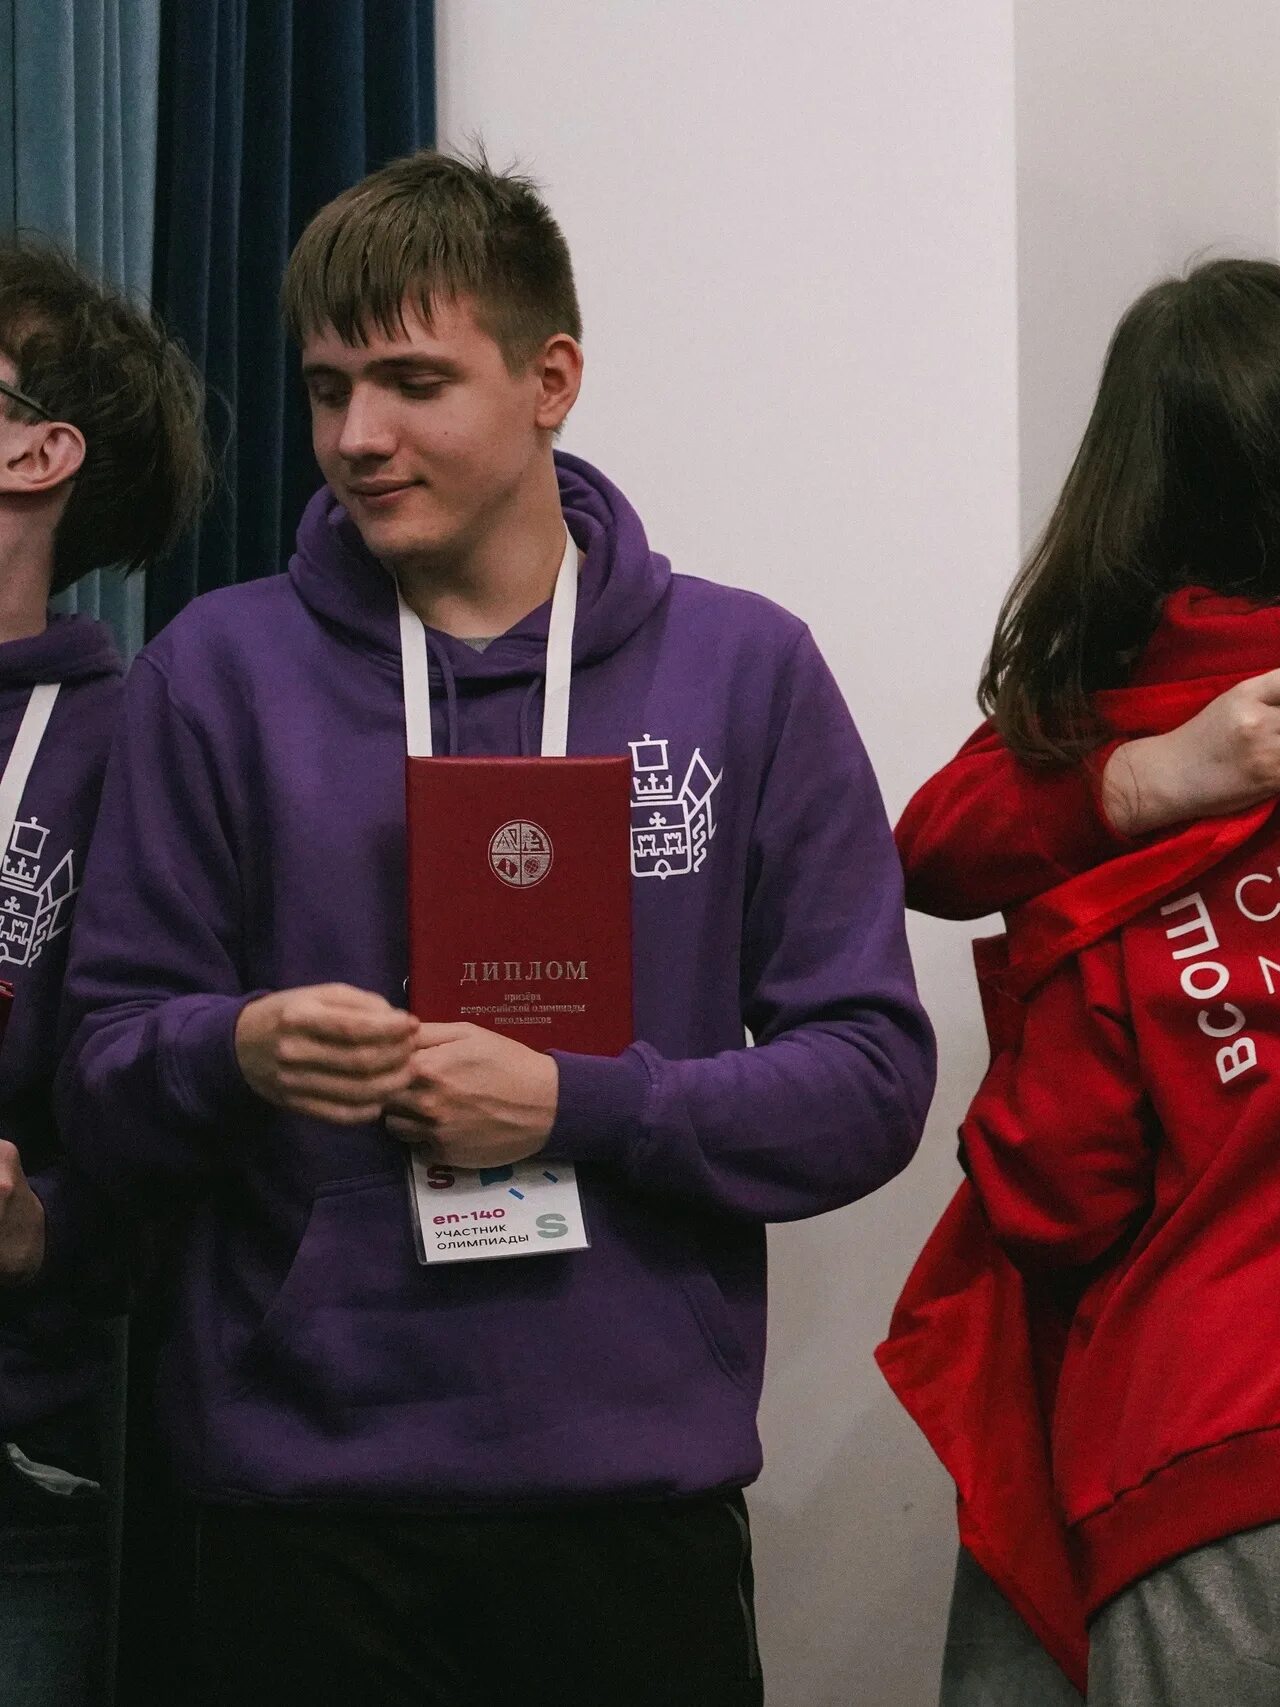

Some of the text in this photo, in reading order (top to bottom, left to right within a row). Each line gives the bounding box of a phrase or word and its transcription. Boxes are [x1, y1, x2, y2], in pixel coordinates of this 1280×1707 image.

[460, 961, 589, 986] ДИПЛОМ
[1160, 891, 1257, 1084] ВСОШ
[532, 1003, 586, 1014] олимпиады
[494, 1015, 552, 1025] школьников
[435, 1224, 508, 1239] УЧАСТНИК
[437, 1234, 529, 1251] ОЛИМПИАДЫ
